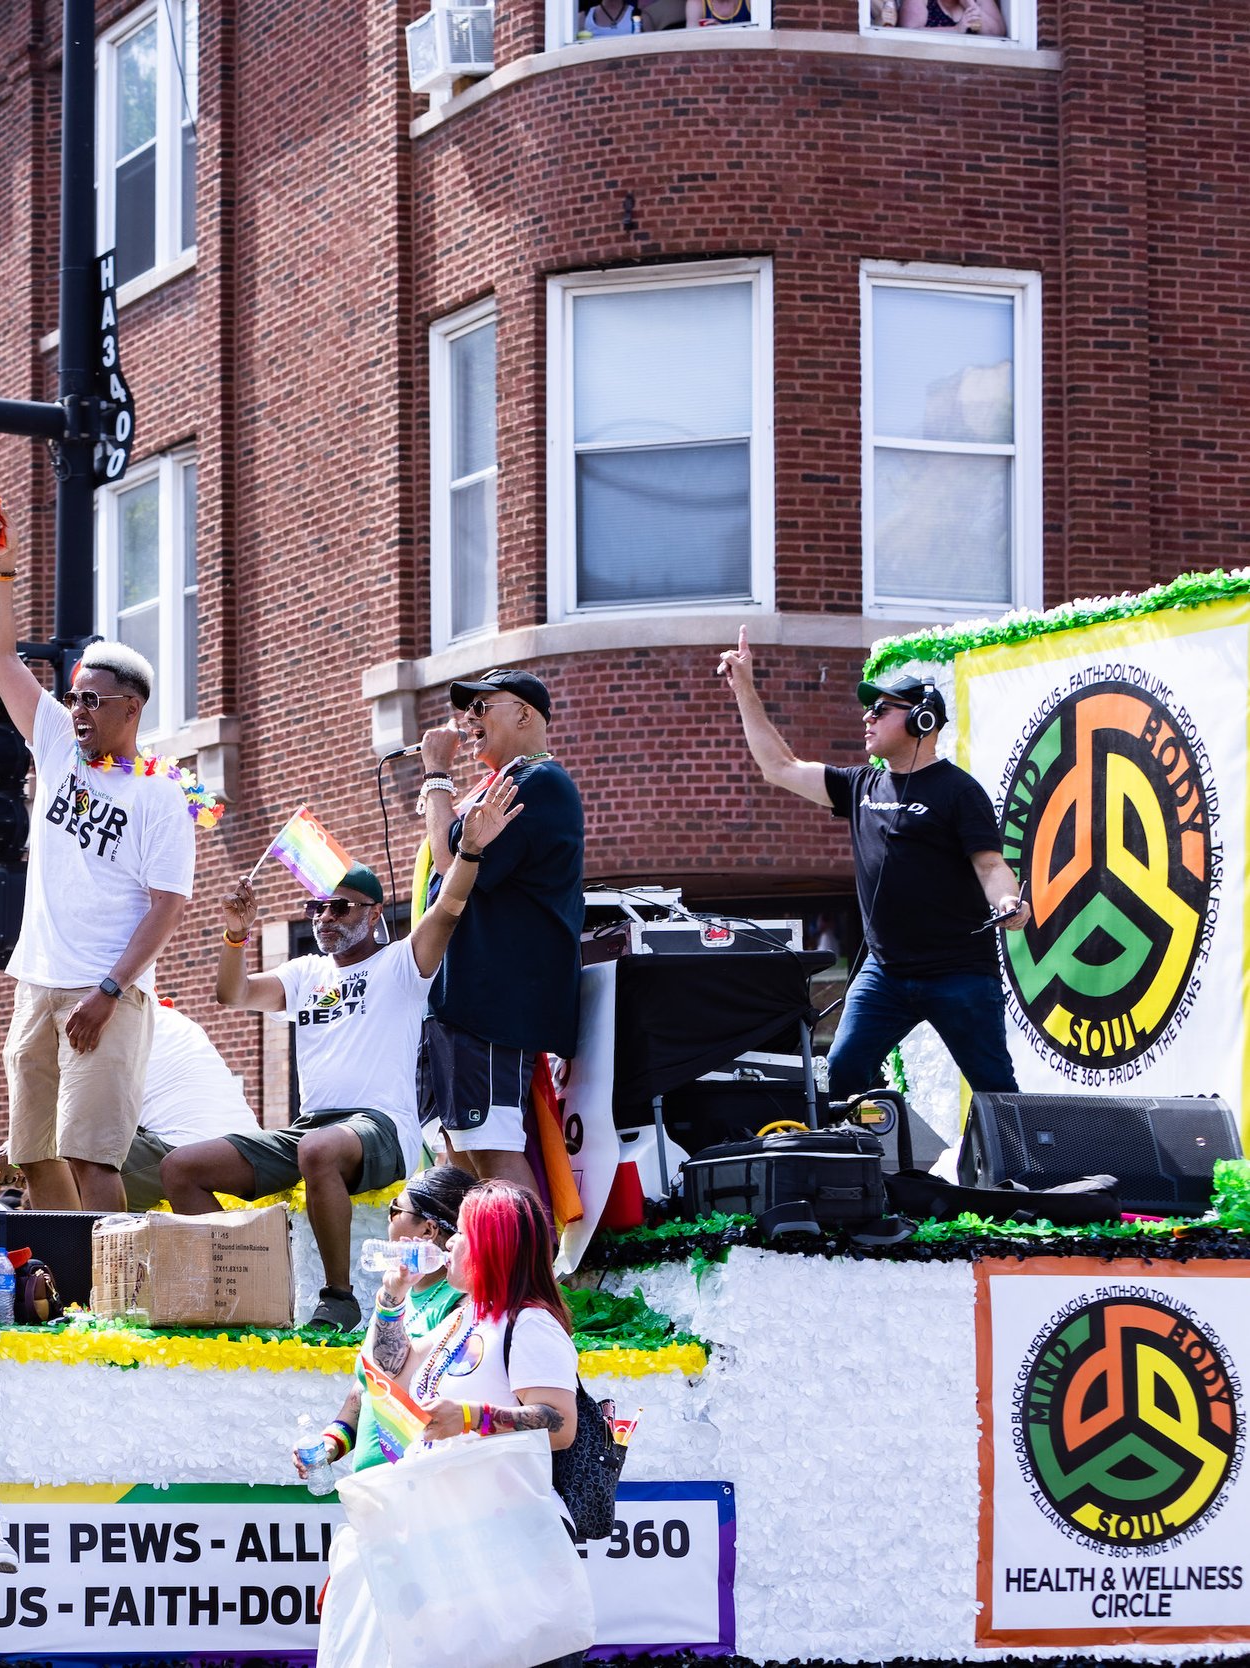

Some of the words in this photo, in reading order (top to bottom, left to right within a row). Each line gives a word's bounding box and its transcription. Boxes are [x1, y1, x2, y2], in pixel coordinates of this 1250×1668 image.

[1022, 687, 1062, 740] CAUCUS
[1151, 676, 1174, 707] UMC
[1176, 706, 1212, 777] PROJECT
[1000, 739, 1024, 790] MEN'S
[1144, 716, 1203, 831] BODY
[907, 803, 929, 815] DJ
[1205, 778, 1220, 828] VIDA
[46, 796, 118, 857] BEST
[111, 836, 121, 862] LIFE
[1211, 841, 1224, 891] TASK
[1199, 897, 1220, 963] FORCE
[298, 1001, 361, 1026] BEST
[1004, 990, 1049, 1060] ALLIANCE
[1050, 1052, 1078, 1082] CARE
[1109, 1058, 1142, 1086] PRIDE
[1143, 1048, 1156, 1070] IN
[1156, 1023, 1177, 1055] THE
[1176, 976, 1201, 1028] PEWS
[1069, 1011, 1146, 1058] SOUL
[1050, 1294, 1089, 1326] CAUCUS
[1174, 1300, 1198, 1321] UMC
[1027, 1323, 1053, 1357] MEN'S
[1200, 1322, 1235, 1371] PROJECT
[1017, 1355, 1034, 1381] GAY
[1029, 1339, 1071, 1425] MIND
[1171, 1325, 1231, 1403] BODY
[1011, 1382, 1025, 1424] BLACK
[1229, 1371, 1244, 1402] VIDA
[1236, 1410, 1247, 1442] TASK
[1012, 1427, 1034, 1483] CHICAGO
[1228, 1447, 1245, 1487] FORCE
[70, 1522, 200, 1563] PEWS
[211, 1539, 225, 1549] -
[606, 1519, 690, 1559] 360
[1030, 1490, 1076, 1540] ALLIANCE
[1076, 1534, 1106, 1555] CARE
[1135, 1541, 1169, 1559] PRIDE
[1170, 1536, 1182, 1550] IN
[1185, 1524, 1205, 1541] THE
[1204, 1492, 1229, 1525] PEWS
[1098, 1509, 1174, 1540] SOUL
[1006, 1567, 1095, 1592] HEALTH
[1101, 1566, 1116, 1592] &
[1122, 1565, 1243, 1590] WELLNESS
[58, 1602, 73, 1613] -
[85, 1584, 320, 1628] FAITH-DOL
[1091, 1593, 1172, 1618] CIRCLE
